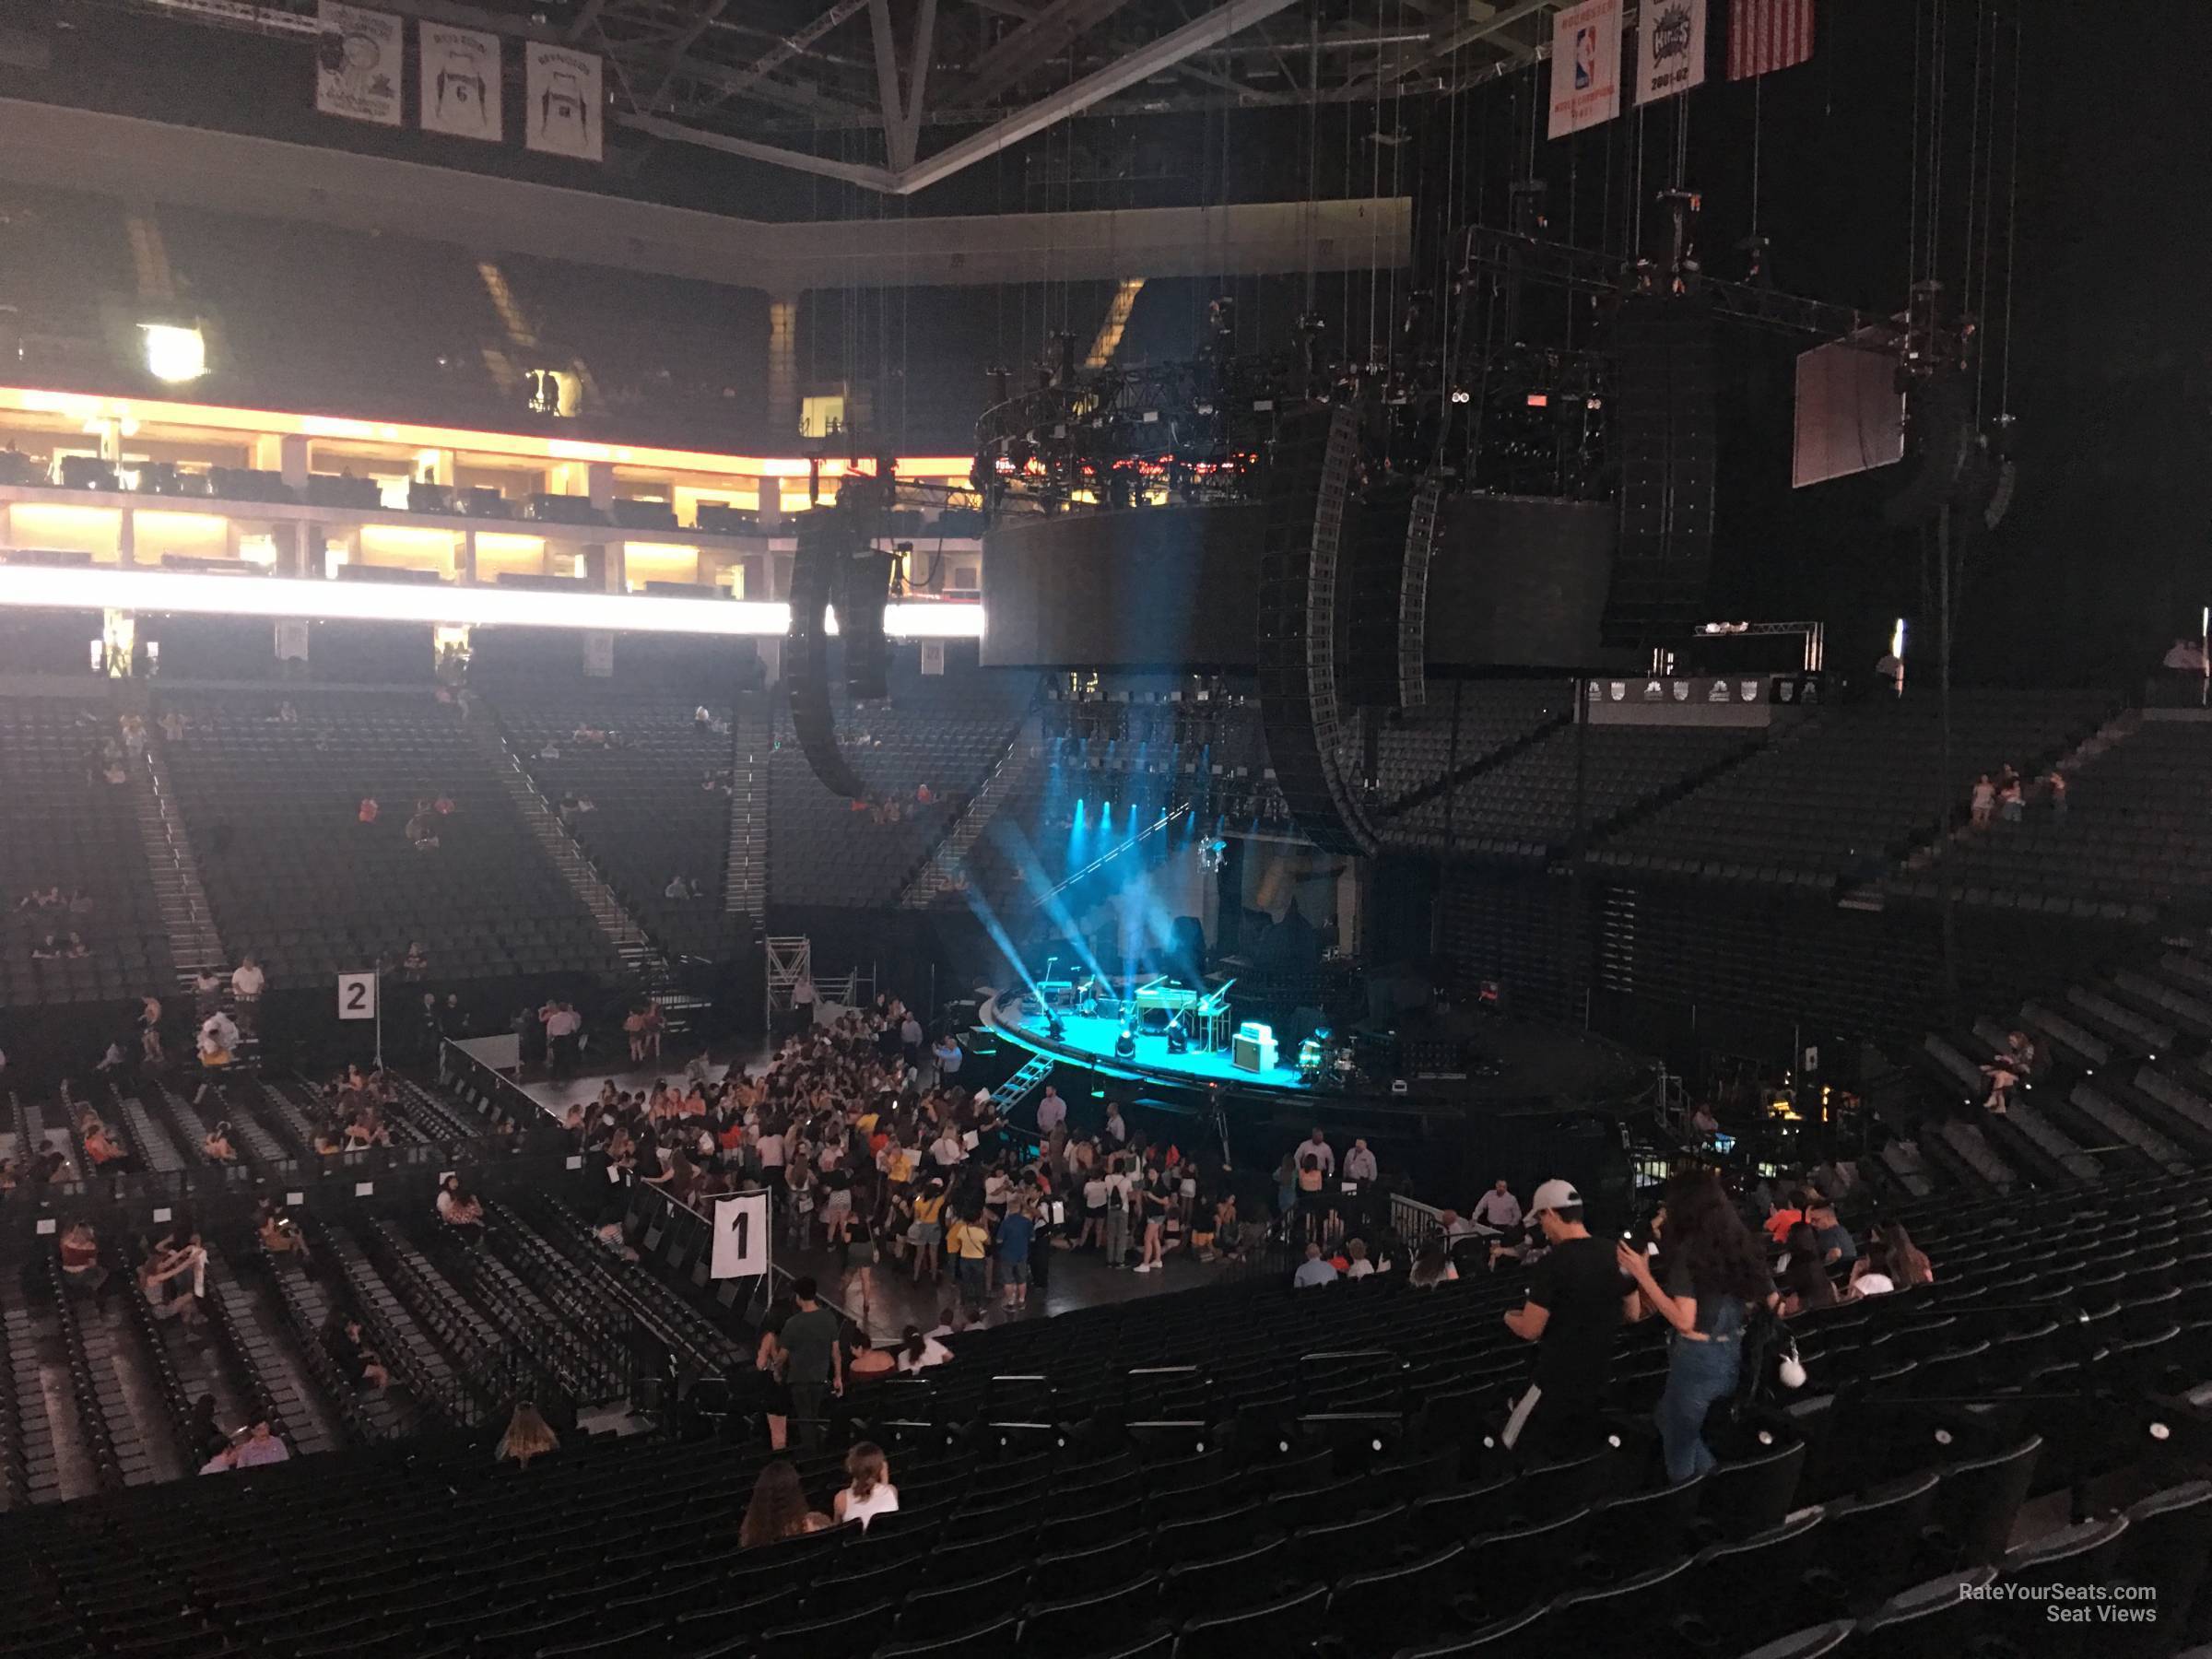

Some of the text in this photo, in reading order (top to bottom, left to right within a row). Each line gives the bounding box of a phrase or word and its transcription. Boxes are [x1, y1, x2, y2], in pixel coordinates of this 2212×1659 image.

[1652, 67, 1688, 90] 2001-02
[347, 982, 366, 1010] 2
[732, 1212, 748, 1260] 1
